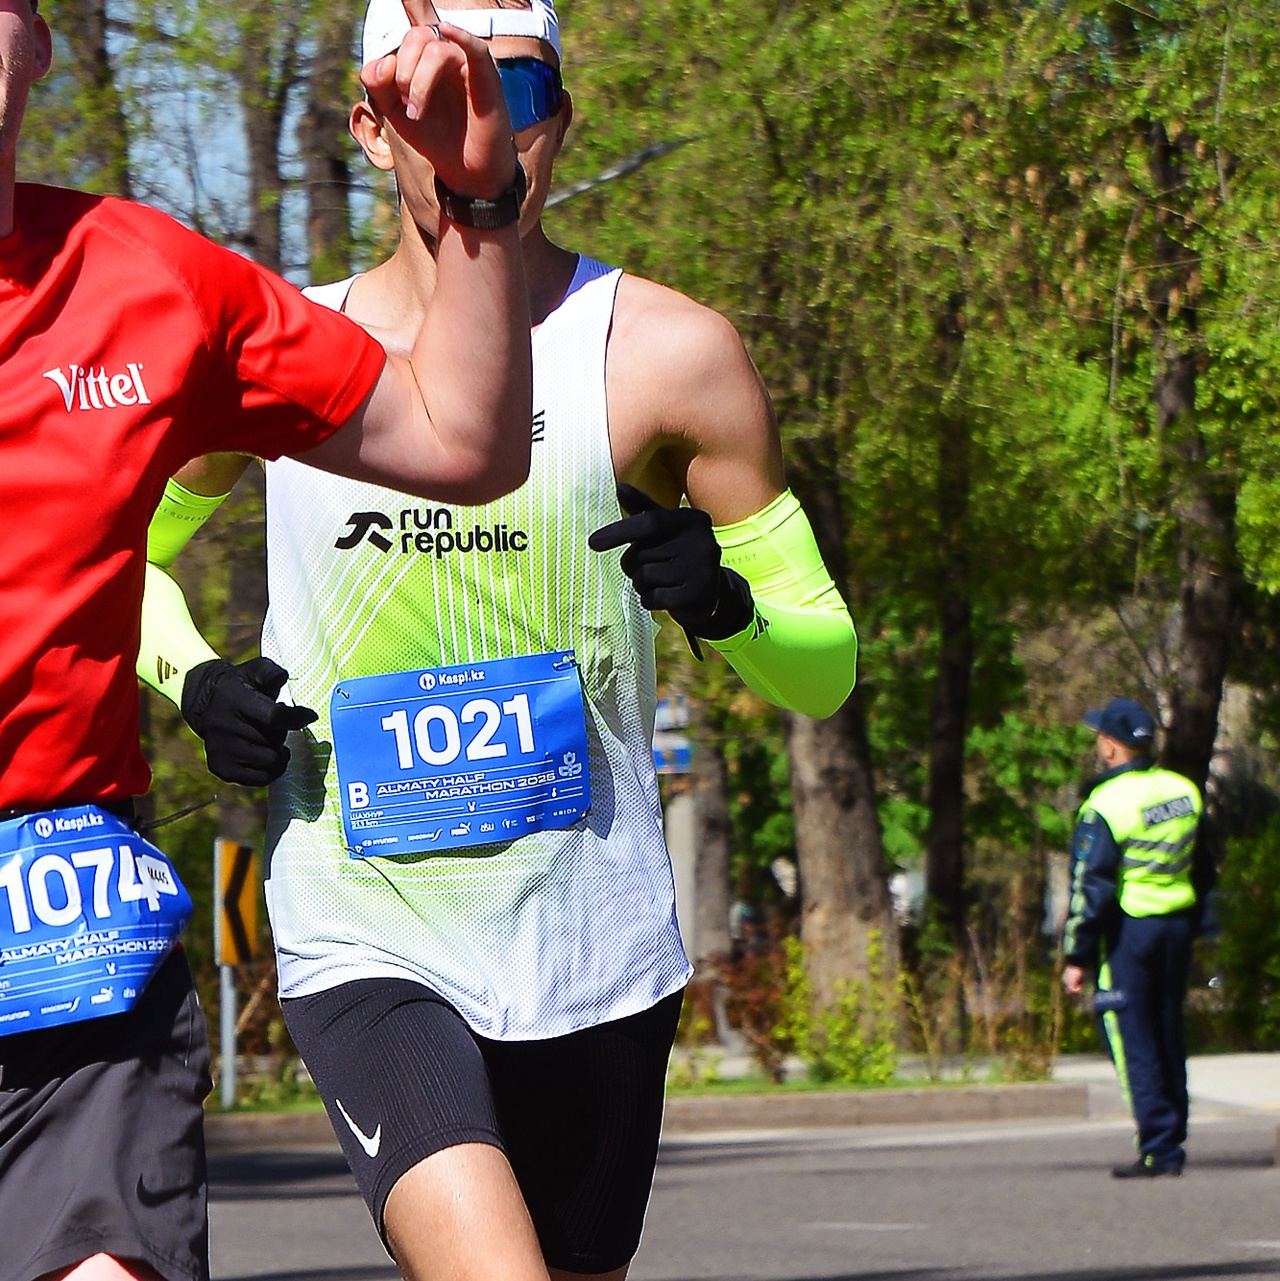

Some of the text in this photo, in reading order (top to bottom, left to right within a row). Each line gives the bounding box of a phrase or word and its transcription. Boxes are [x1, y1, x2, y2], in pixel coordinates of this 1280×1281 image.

[42, 362, 152, 413] Vittel
[399, 507, 453, 531] run
[400, 524, 529, 560] republic
[380, 692, 536, 770] 1021
[347, 782, 371, 810] B
[376, 772, 487, 796] ALMATY HALF
[425, 779, 517, 801] MARATHON
[0, 929, 120, 963] ALMATY HALF
[55, 939, 148, 966] MARATHON
